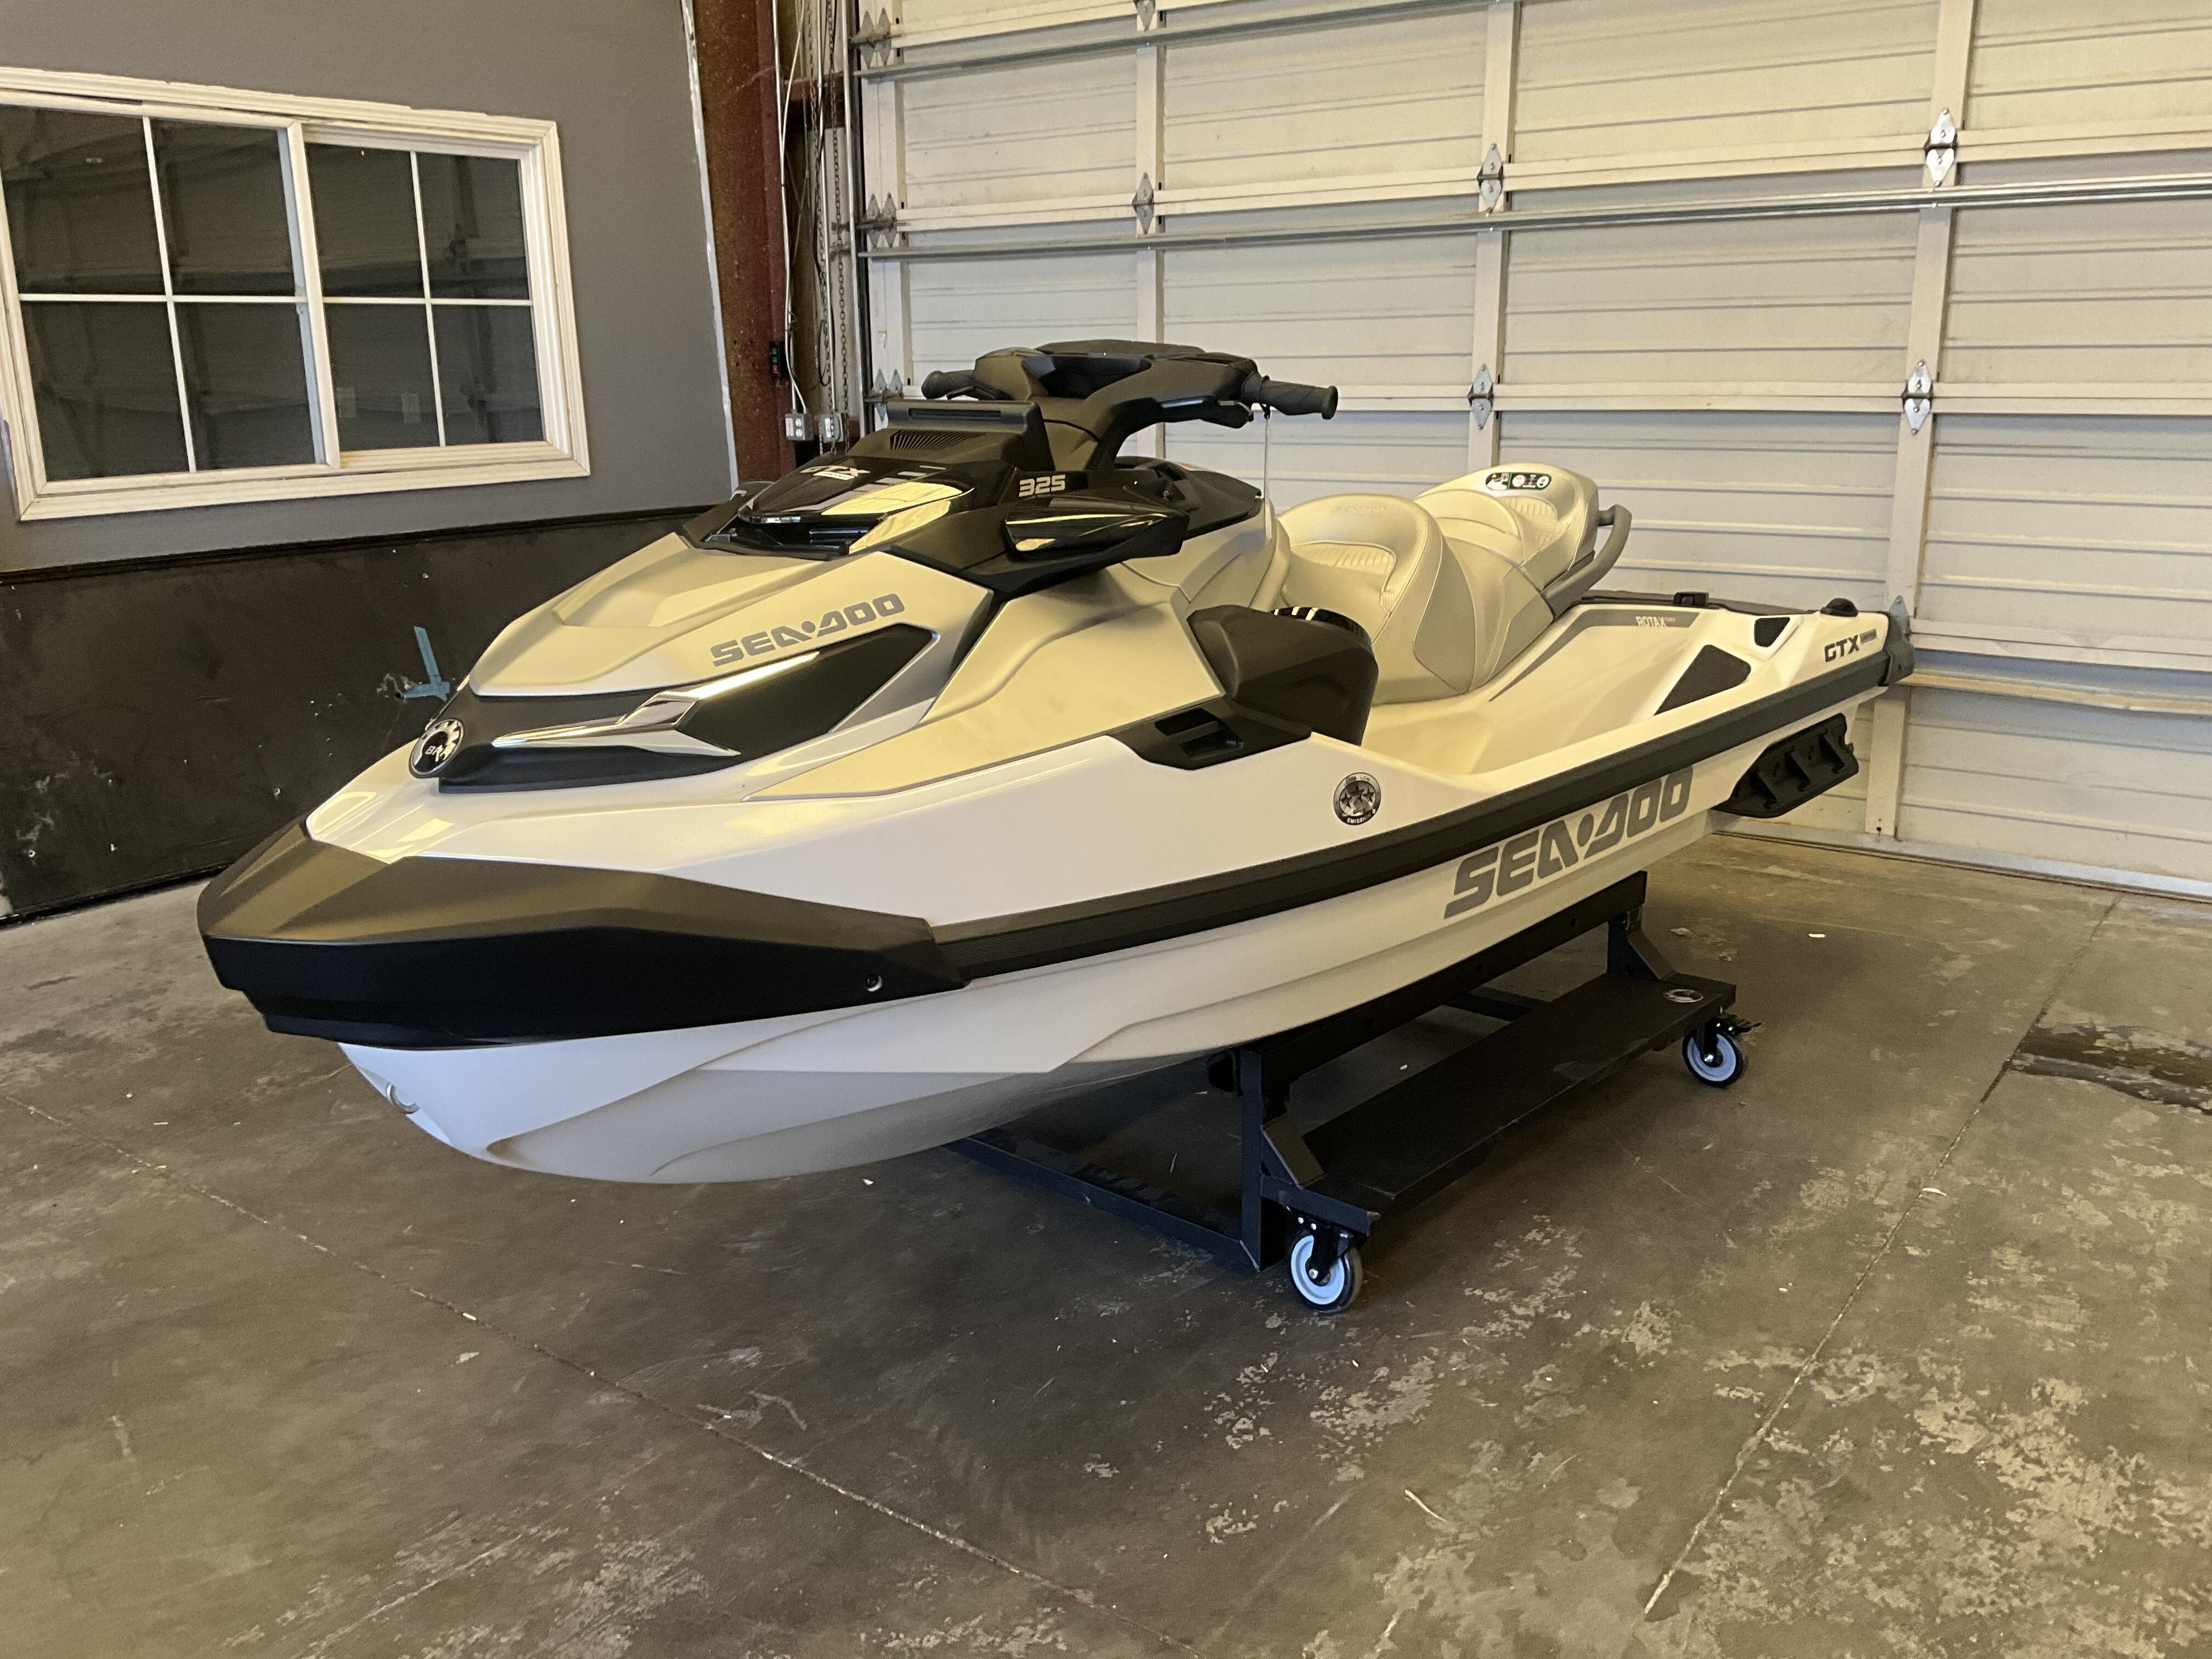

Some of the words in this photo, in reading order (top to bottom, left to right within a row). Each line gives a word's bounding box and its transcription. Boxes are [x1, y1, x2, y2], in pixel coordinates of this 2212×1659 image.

[1019, 474, 1065, 498] 325
[1635, 616, 1667, 628] ROTAX
[1824, 634, 1859, 662] GTX
